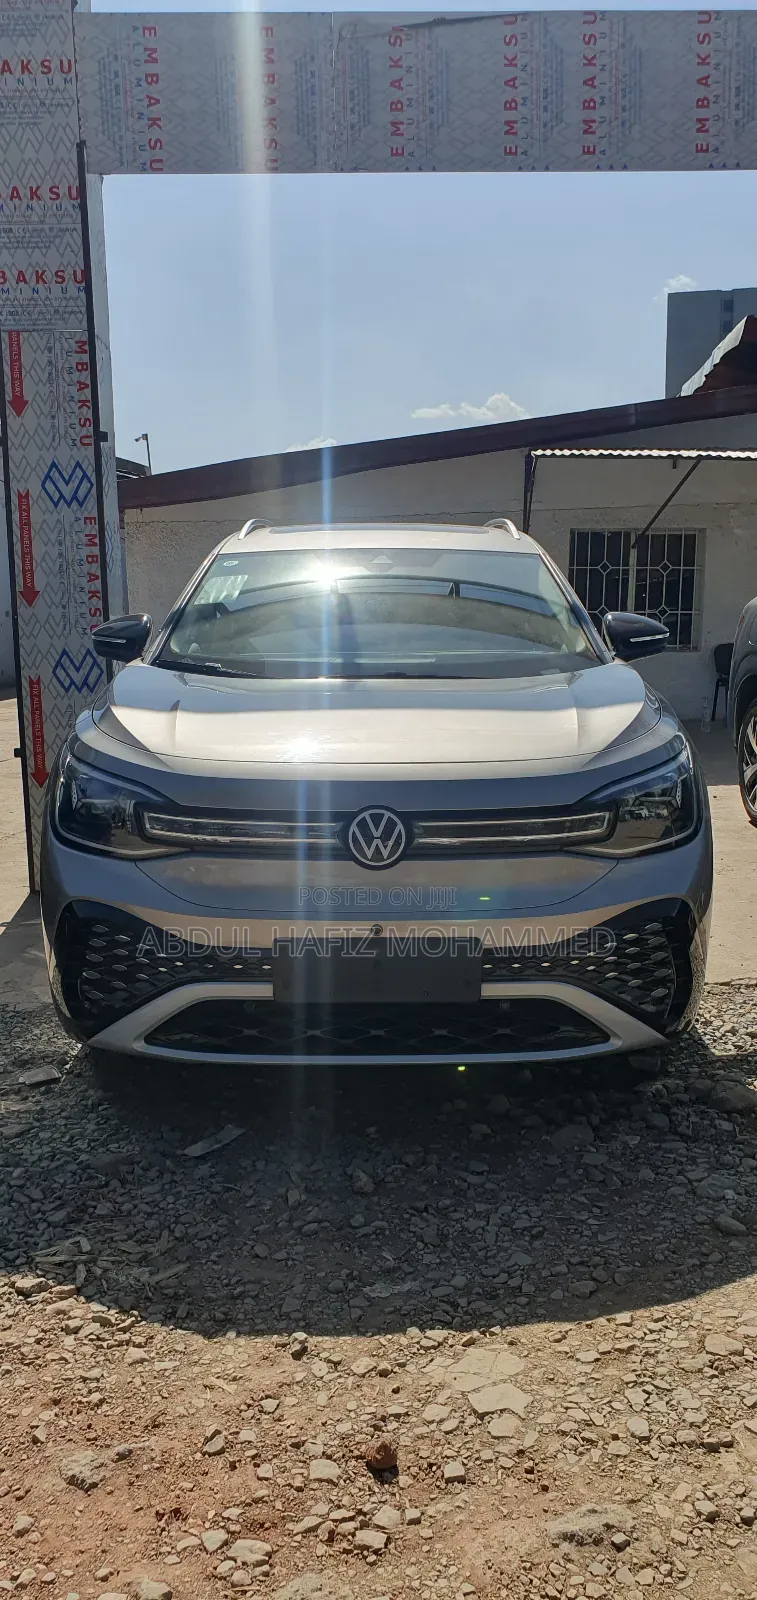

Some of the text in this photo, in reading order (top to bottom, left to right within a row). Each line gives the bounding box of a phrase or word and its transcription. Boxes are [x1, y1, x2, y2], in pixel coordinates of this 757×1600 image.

[0, 59, 73, 75] AKSU
[130, 25, 147, 172] ALUMINIUM
[142, 25, 164, 172] EMBAKSU
[503, 14, 518, 157] EMBAKSU
[582, 11, 597, 155] EMBAKSU
[598, 12, 607, 156] ALUMINIUM
[695, 11, 712, 153] EMBAKSU
[0, 185, 80, 201] AKSU
[0, 269, 86, 284] BAKSU
[75, 340, 93, 447] MBAKSU
[22, 525, 30, 553] PANELS
[74, 515, 88, 636] ALUMINIUM
